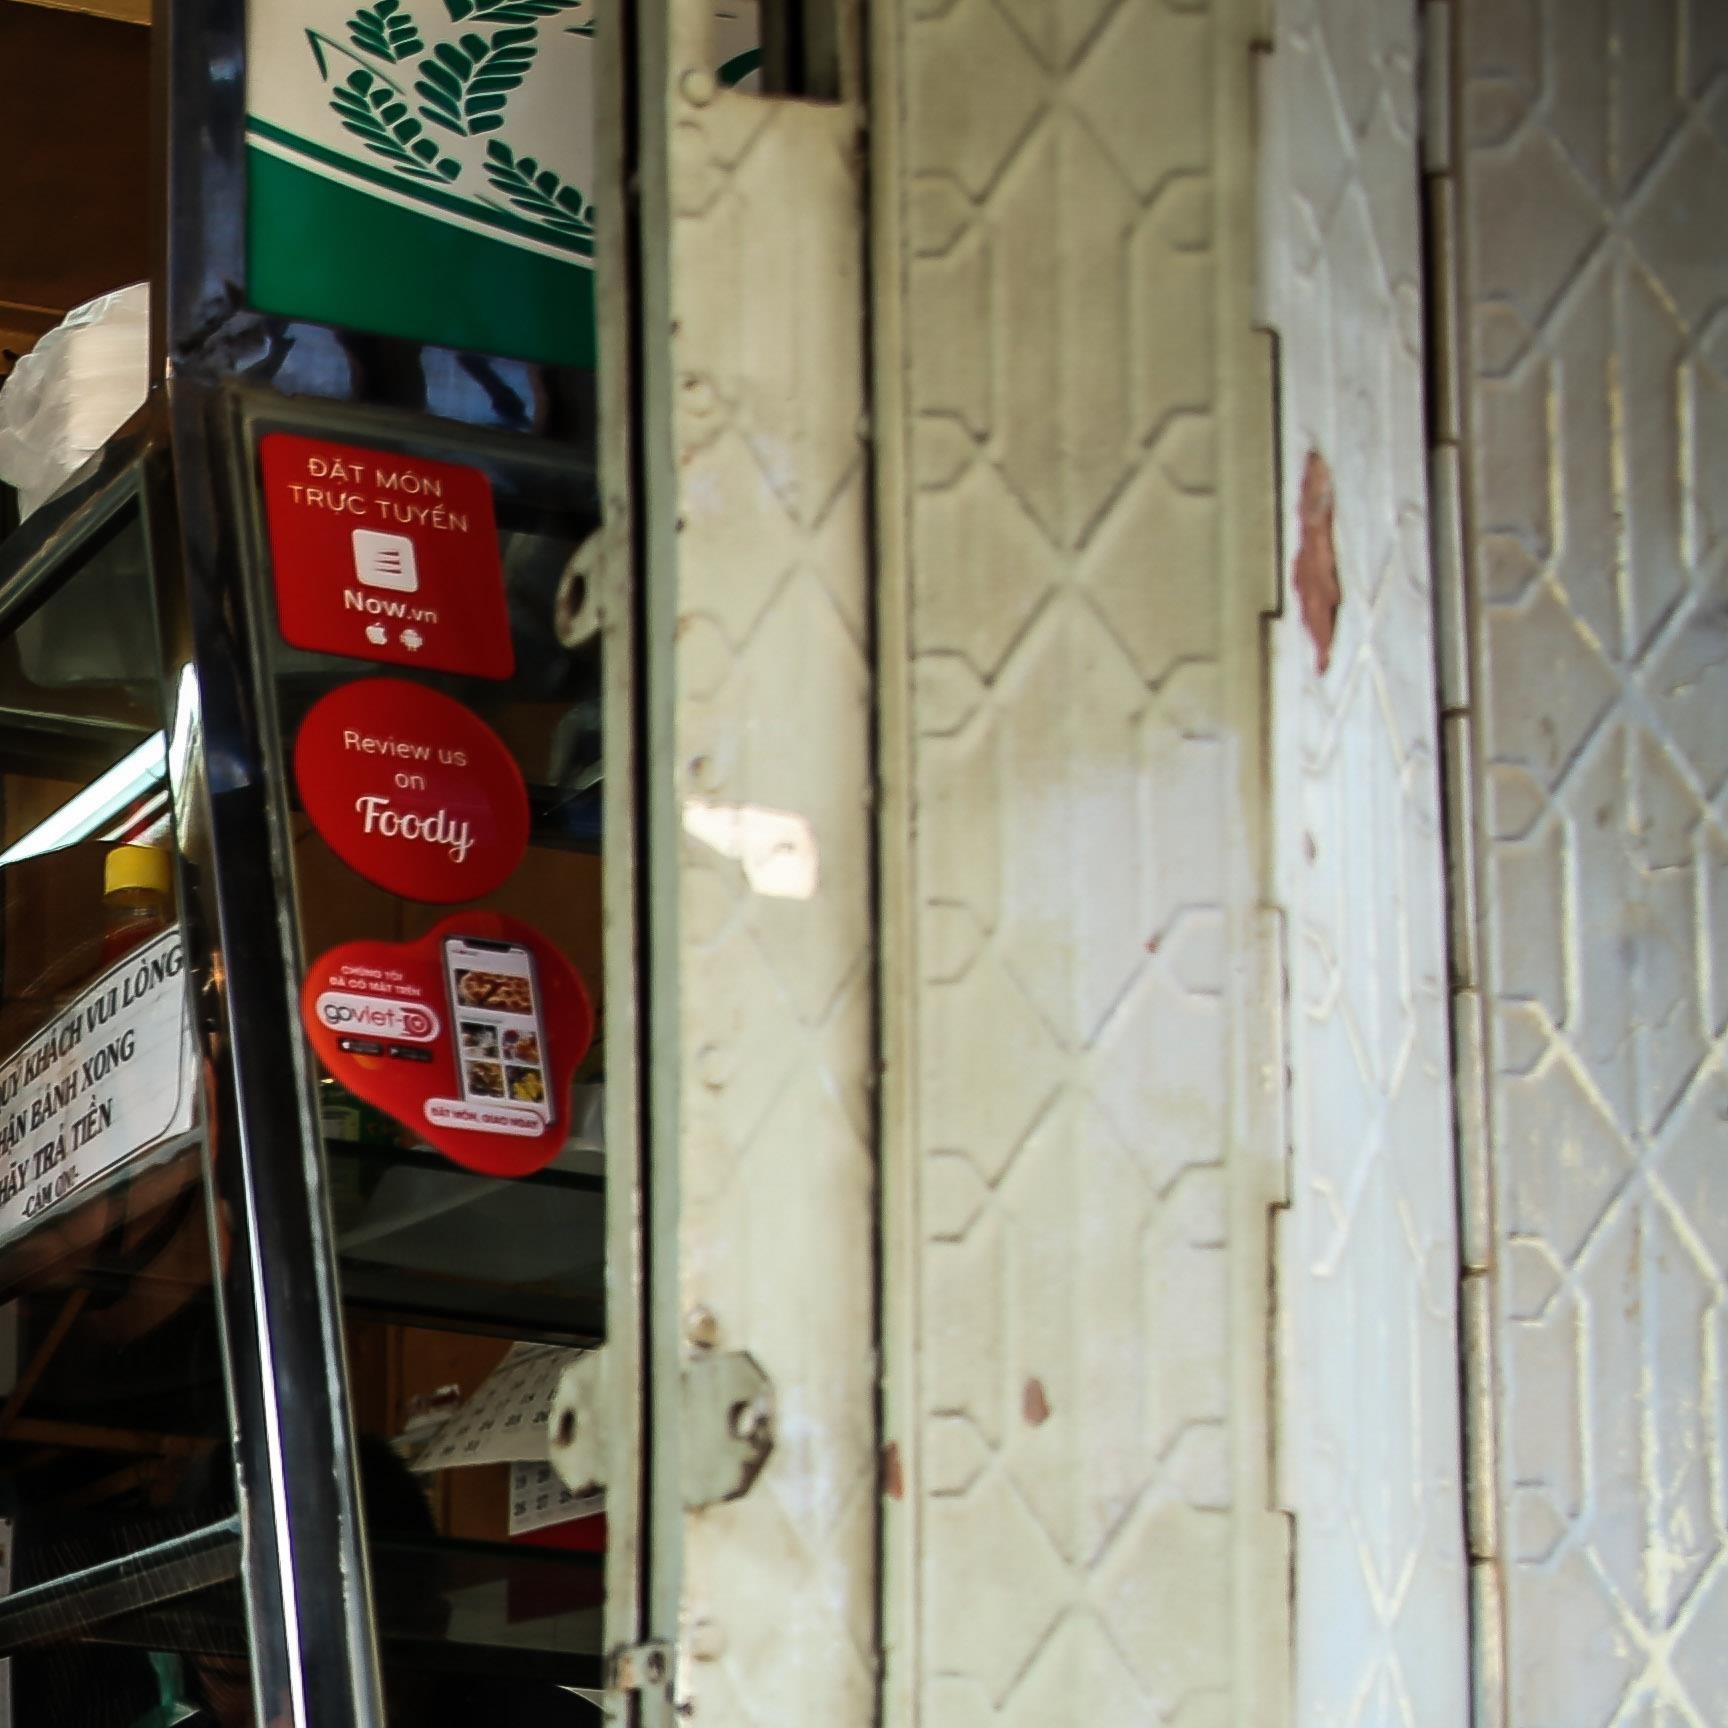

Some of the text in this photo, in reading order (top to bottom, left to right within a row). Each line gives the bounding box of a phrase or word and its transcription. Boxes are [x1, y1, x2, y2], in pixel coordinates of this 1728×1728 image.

[307, 457, 365, 485] ĐẶT
[288, 485, 468, 533] TRỰC TUYẾN
[344, 730, 467, 767] Review us
[395, 773, 425, 790] on
[355, 796, 474, 863] Foody
[87, 988, 117, 1034] VUI
[122, 944, 184, 1008] LÒNG
[81, 1029, 135, 1091] XONG
[71, 1095, 113, 1151] TIỀN
